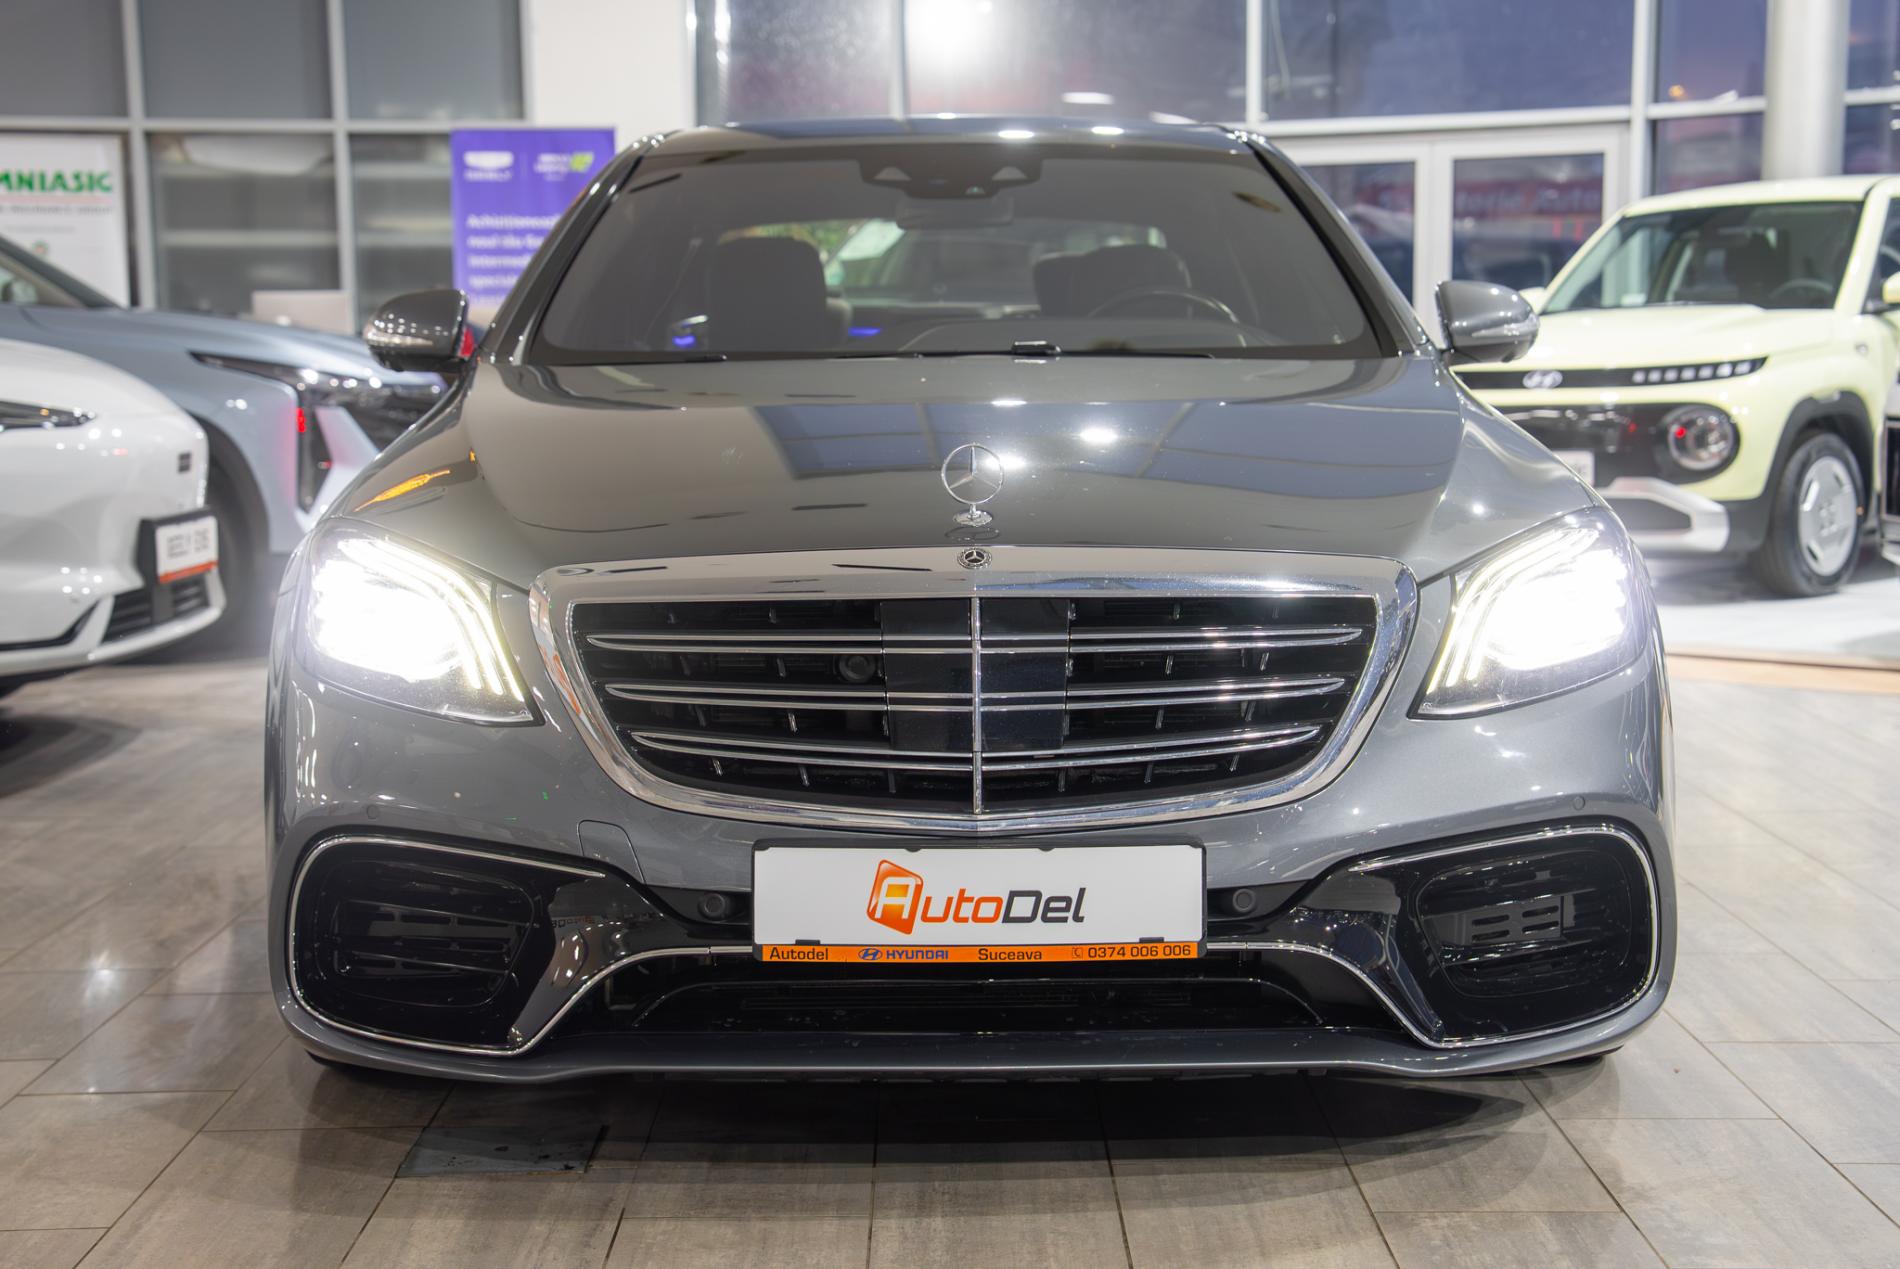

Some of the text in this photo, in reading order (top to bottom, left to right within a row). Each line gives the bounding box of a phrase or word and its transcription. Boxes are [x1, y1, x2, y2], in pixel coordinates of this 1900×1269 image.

[872, 875, 1087, 924] AutoDel
[769, 944, 1192, 961] Autodel HYUNDAI Suceava 0374 006 006
